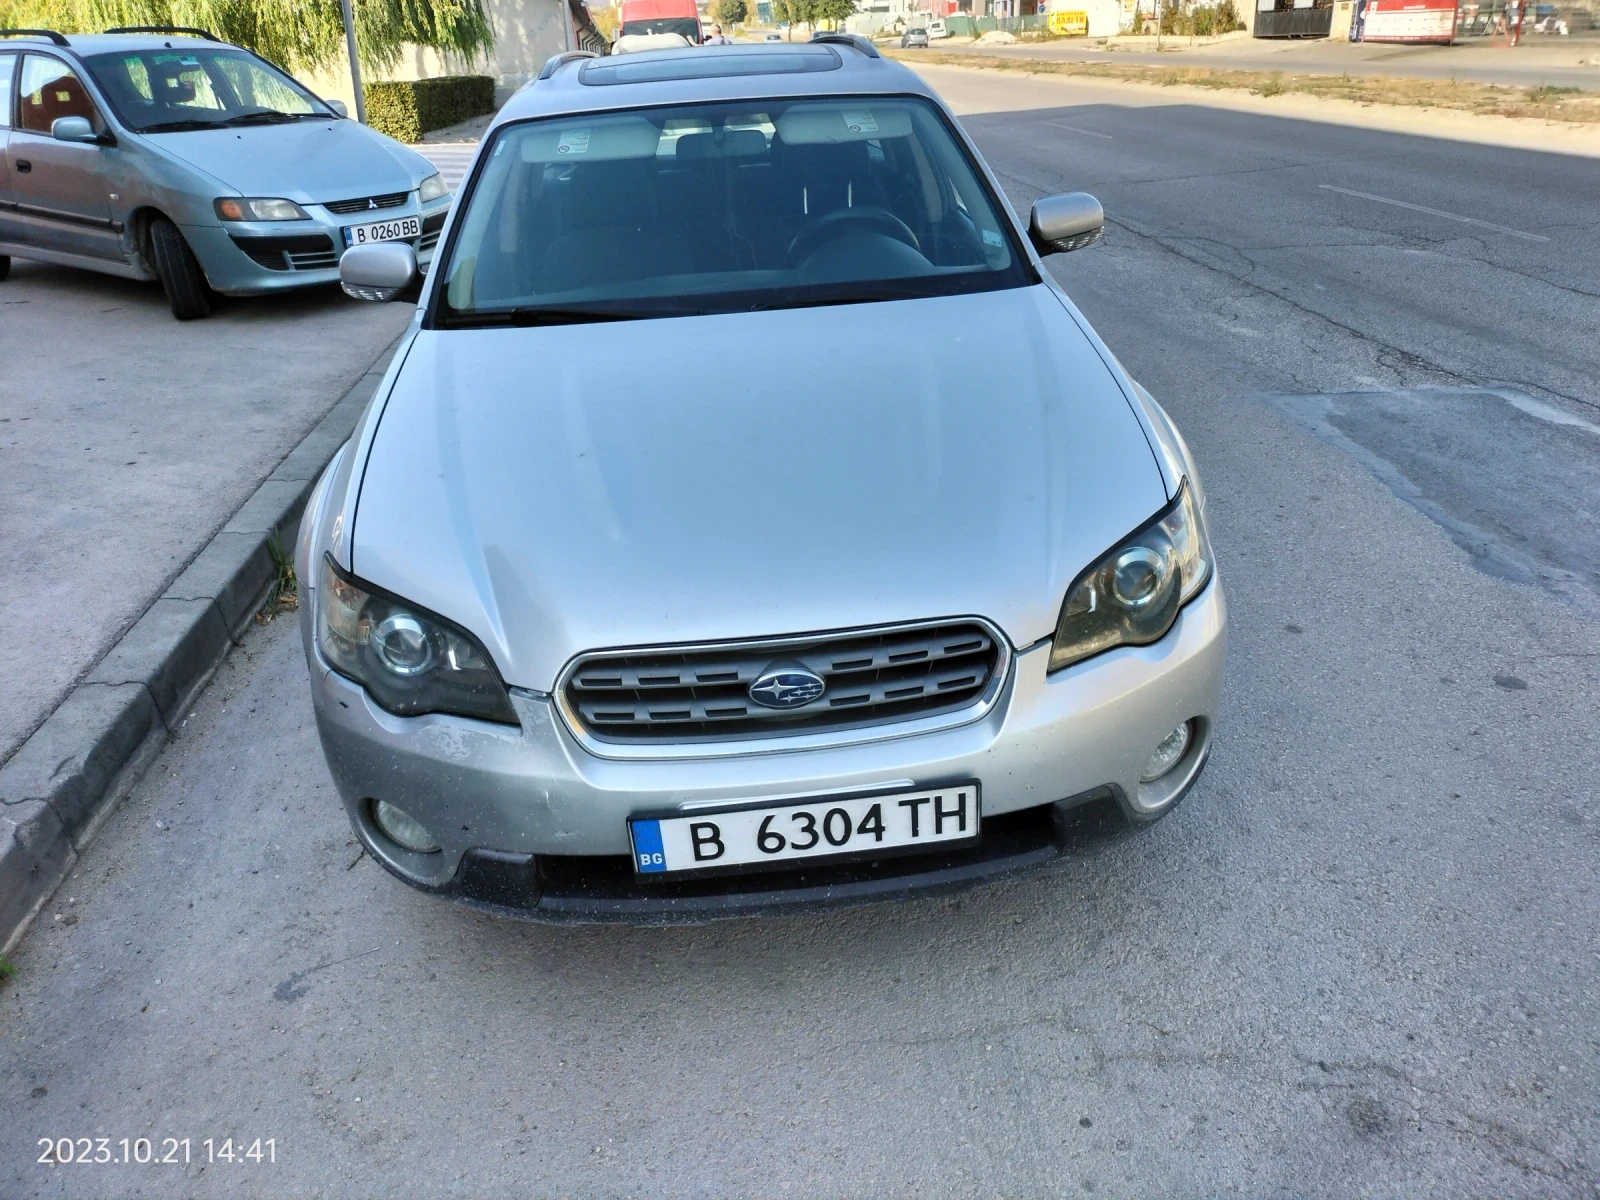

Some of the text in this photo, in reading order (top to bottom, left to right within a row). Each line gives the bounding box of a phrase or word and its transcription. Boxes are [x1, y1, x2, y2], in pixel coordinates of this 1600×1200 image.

[1056, 16, 1085, 25] ПАЛЕТИ
[357, 228, 366, 243] B
[371, 223, 400, 240] 0260
[402, 220, 419, 236] BB
[689, 792, 967, 862] B 6304 TH
[640, 853, 664, 867] BG
